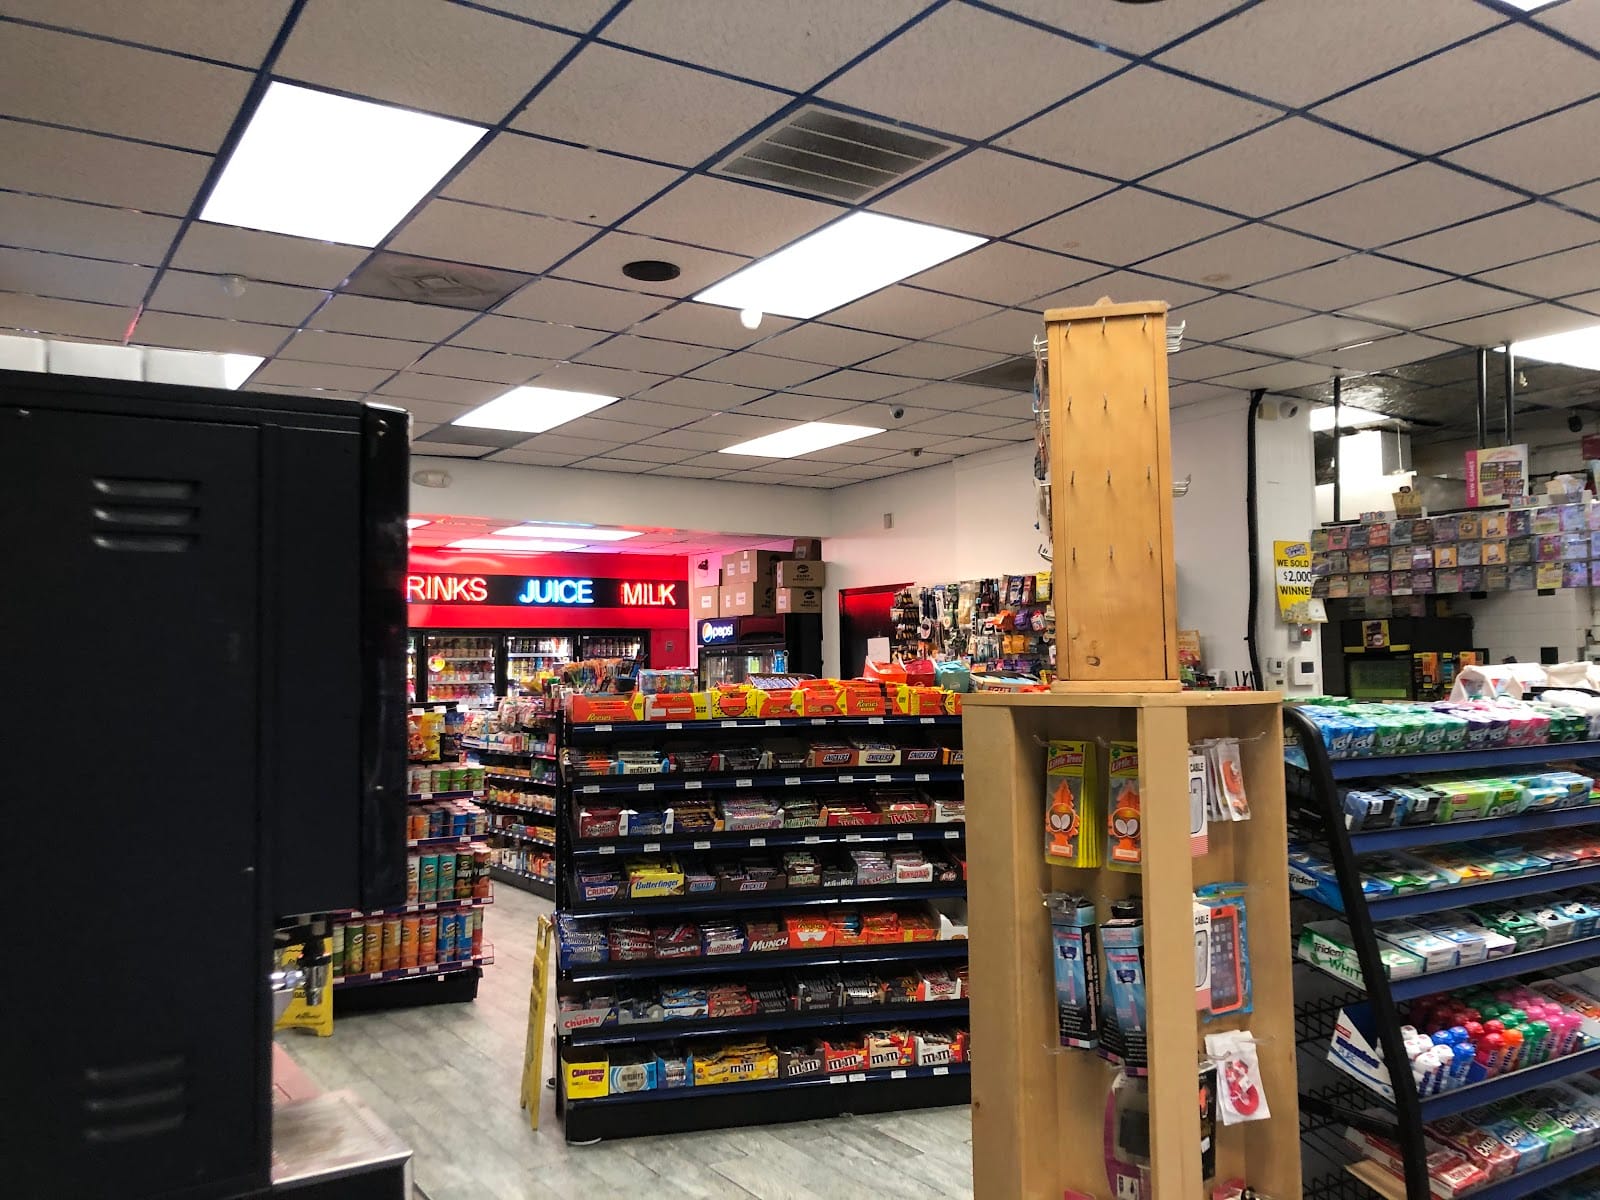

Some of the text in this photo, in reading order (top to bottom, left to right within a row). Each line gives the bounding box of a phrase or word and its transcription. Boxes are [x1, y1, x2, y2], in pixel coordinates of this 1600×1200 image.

[1276, 559, 1310, 568] WE SOLD
[405, 575, 488, 602] RINKS
[518, 578, 595, 604] JUICE
[621, 582, 677, 606] MILK
[1280, 586, 1312, 596] WINNE
[711, 623, 734, 640] pepsi
[908, 750, 938, 760] SNICKERS
[888, 811, 917, 824] Twix
[636, 879, 679, 890] Butterfinger
[1288, 873, 1318, 887] Trident
[586, 886, 616, 897] CRUNCH
[750, 937, 789, 952] MUNCH
[1314, 942, 1345, 958] Trident
[1329, 957, 1361, 981] WHIT
[564, 1015, 600, 1029] Chunky
